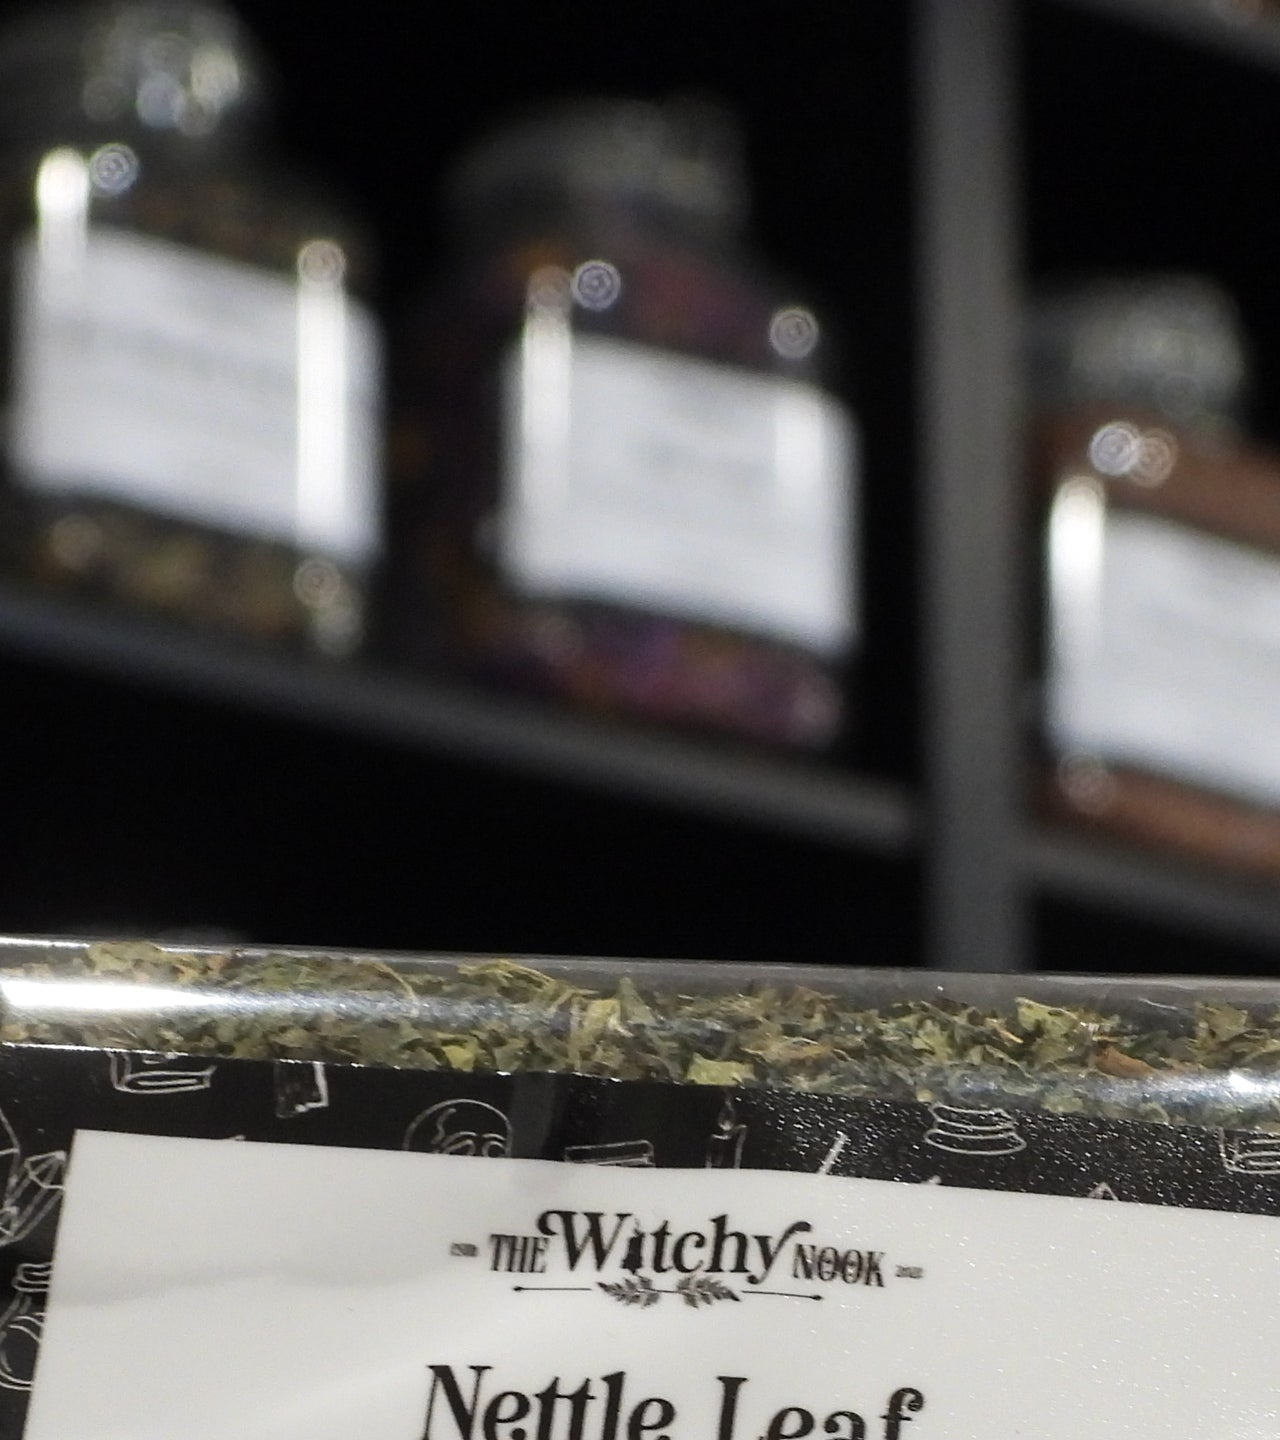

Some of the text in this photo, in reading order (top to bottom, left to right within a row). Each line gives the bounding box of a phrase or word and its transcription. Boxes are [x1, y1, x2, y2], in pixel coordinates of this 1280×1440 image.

[489, 1209, 887, 1288] THE Witchy NOOK
